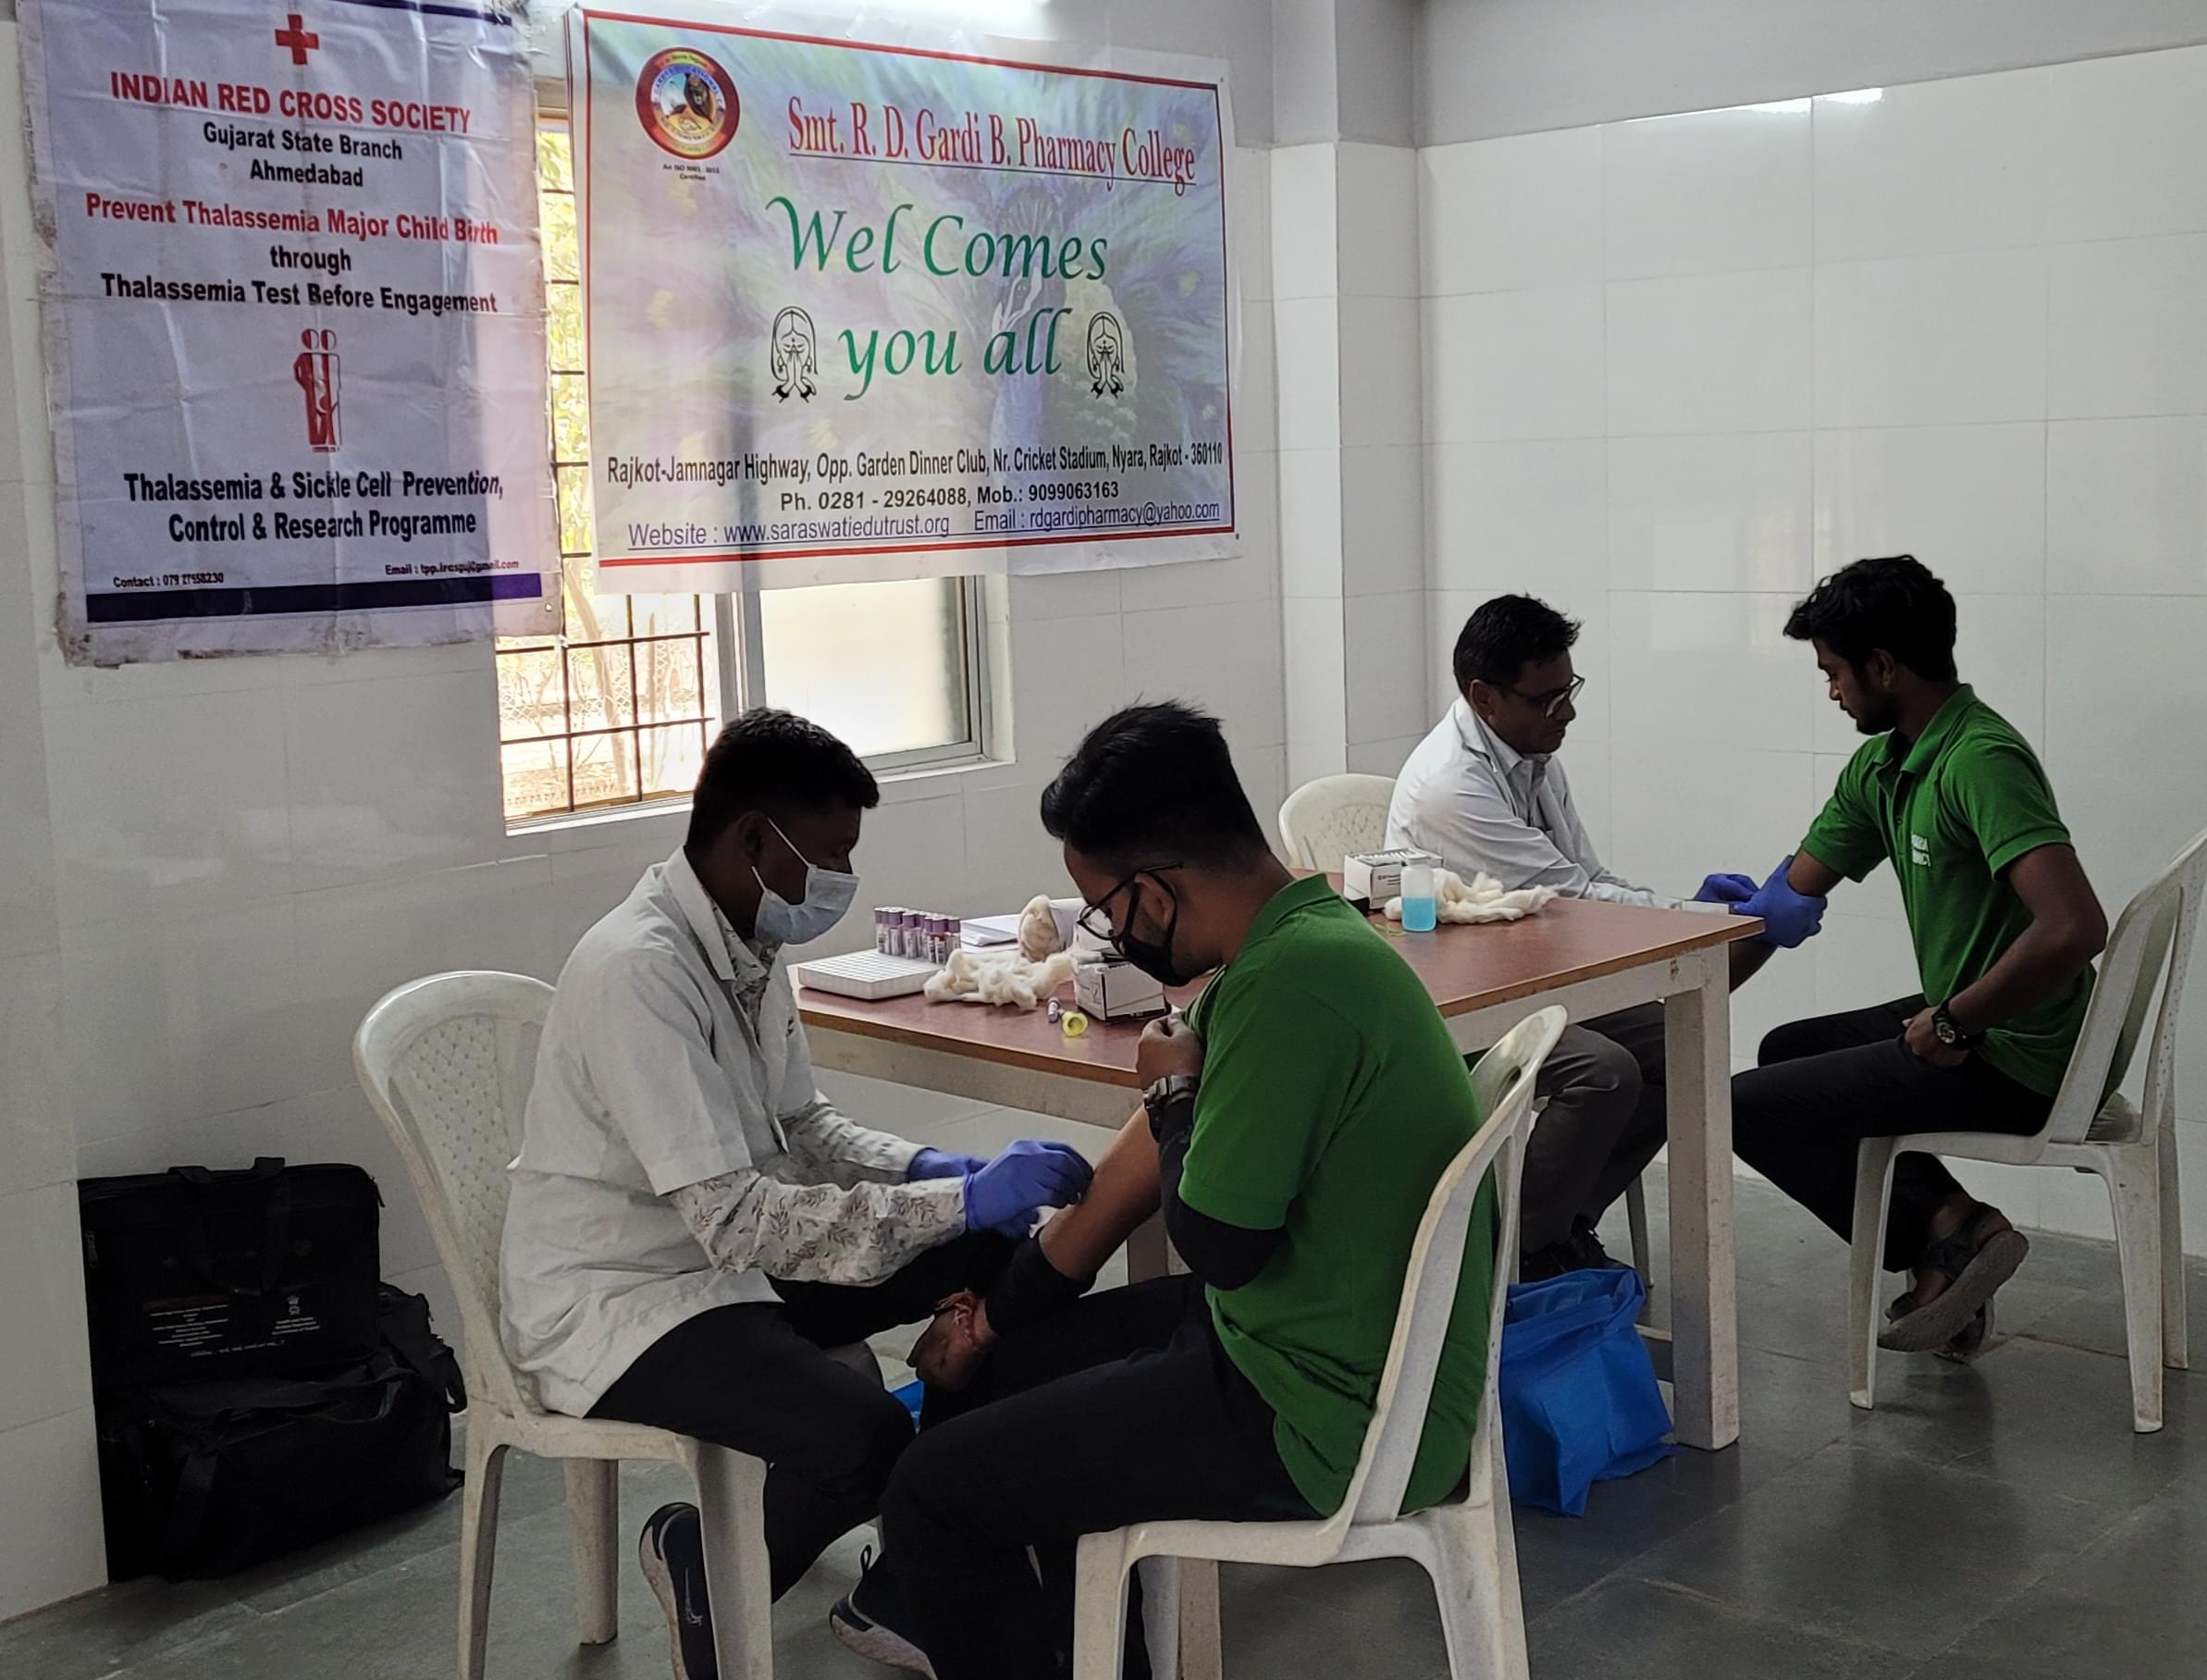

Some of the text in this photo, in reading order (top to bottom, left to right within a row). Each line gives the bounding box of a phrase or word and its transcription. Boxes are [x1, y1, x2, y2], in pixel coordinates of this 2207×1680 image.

[111, 71, 471, 133] INDIAN RED CROSS SOCIETY
[203, 121, 402, 160] Gujarat State Branch
[788, 95, 844, 153] Smt.
[850, 102, 876, 155] R.
[883, 105, 908, 158] D.
[916, 108, 983, 164] Gardi
[988, 114, 1011, 166] B.
[1016, 117, 1116, 191] Pharmacy
[1122, 127, 1195, 196] College
[250, 158, 364, 187] Ahmedabad
[86, 192, 499, 245] Prevent Thalassemia Major Child Birth
[765, 196, 1108, 280] Wel Comes
[270, 244, 351, 276] through
[101, 272, 498, 316] Thalassemia Test Before Engagement
[837, 308, 1073, 401] you all
[123, 469, 503, 501] Thalassemia & Sickle Cell Prevention,
[608, 455, 740, 489] Rajkot-Jamnagar
[744, 453, 811, 486] Highway,
[817, 452, 852, 484] Opp.
[857, 451, 906, 477] Garden
[909, 451, 954, 476] Dinner
[956, 449, 990, 477] Club,
[993, 448, 1011, 472] Nr.
[1014, 447, 1057, 472] Cricket
[1058, 445, 1109, 472] Stadium,
[1112, 444, 1147, 474] Nyara,
[1149, 442, 1183, 472] Rajkot
[1190, 442, 1222, 465] 360110
[781, 493, 811, 511] Ph.
[819, 491, 864, 510] 0281
[883, 488, 971, 508] 29264088,
[1029, 481, 1119, 501] 9099063163
[168, 510, 476, 542] Control & Research Programme
[629, 522, 707, 546] Website
[724, 514, 949, 542] www.saraswatiedutrust.org
[974, 508, 1016, 531] Email
[1030, 500, 1220, 532] rdgardipharmacy@yahoo.com
[113, 575, 154, 587] Contact
[163, 574, 179, 587] 079
[385, 564, 413, 575] Email
